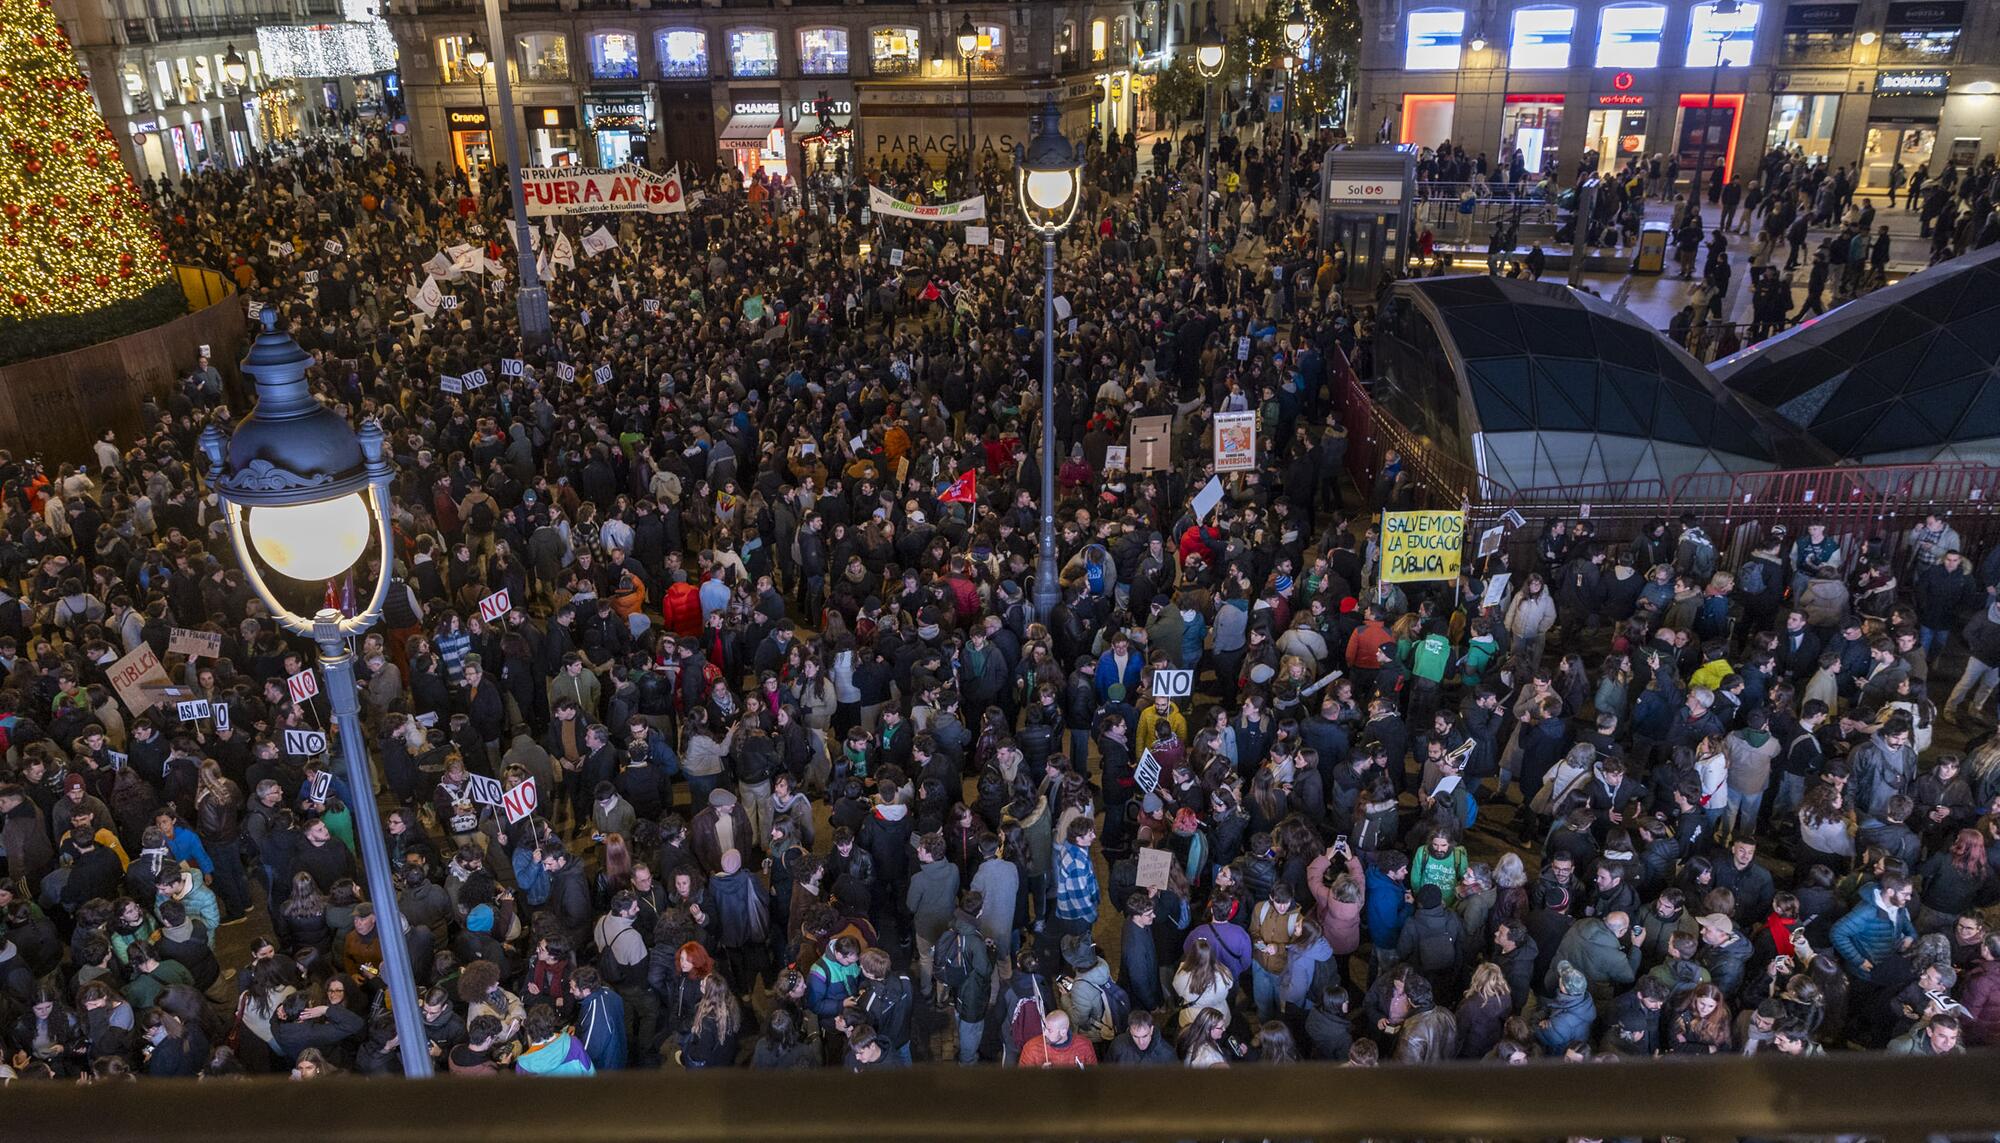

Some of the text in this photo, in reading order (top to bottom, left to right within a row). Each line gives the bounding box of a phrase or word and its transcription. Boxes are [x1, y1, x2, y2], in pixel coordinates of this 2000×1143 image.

[1882, 76, 1942, 88] RODILLA
[1600, 94, 1644, 104] vodafone
[595, 104, 641, 114] CHANGE
[735, 103, 780, 113] CHANGE
[452, 112, 485, 123] Orange
[730, 140, 763, 148] CHANGE
[877, 134, 1013, 153] PARAGUAS
[618, 162, 630, 174] NI
[523, 178, 603, 206] FUERA
[1348, 185, 1363, 195] Sol
[565, 204, 600, 214] Sindicato
[305, 271, 318, 283] NO
[249, 301, 262, 319] NO
[441, 296, 456, 308] NO!
[644, 300, 659, 311] NO
[502, 360, 522, 374] NO
[558, 362, 574, 380] NO
[596, 365, 611, 384] NO
[463, 371, 485, 388] NO
[1218, 456, 1252, 465] INVERSIÓN
[1387, 515, 1462, 533] SALVEMOS
[1388, 535, 1402, 551] LA
[1392, 552, 1444, 574] PÚBLICA
[481, 590, 510, 621] NO
[171, 628, 186, 637] SIN
[112, 650, 158, 692] PÚBLICA
[289, 670, 317, 702] NO
[1154, 671, 1191, 695] NO
[196, 702, 208, 717] NO
[287, 731, 325, 754] NO
[1144, 753, 1159, 777] NO
[312, 772, 328, 799] NO
[472, 776, 504, 804] NO
[505, 780, 536, 822] NO
